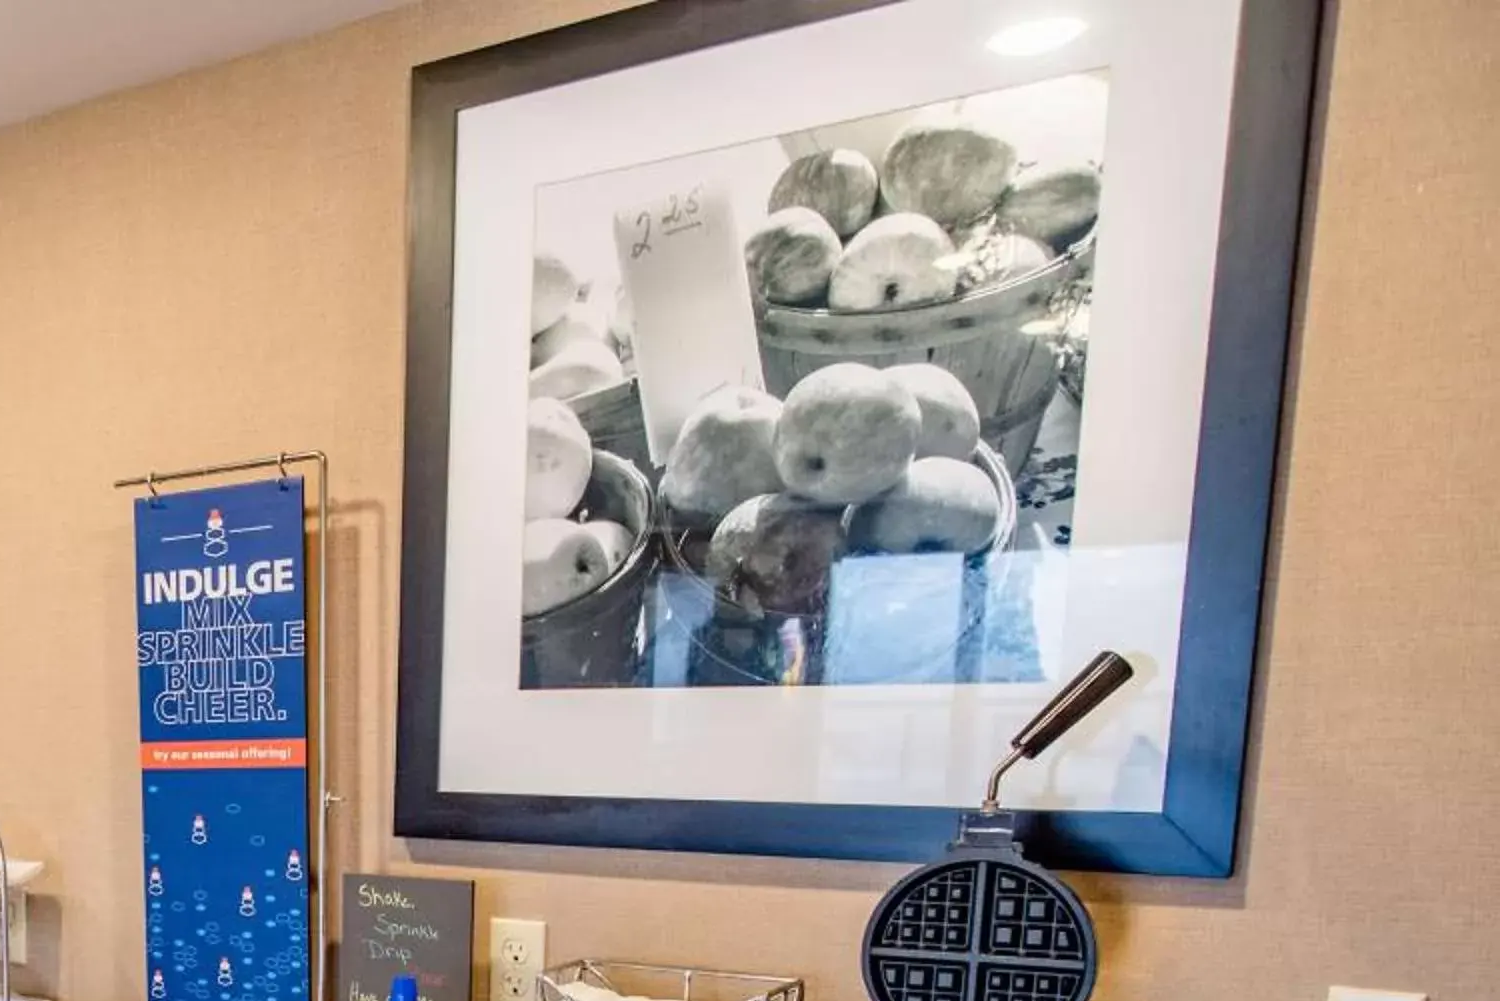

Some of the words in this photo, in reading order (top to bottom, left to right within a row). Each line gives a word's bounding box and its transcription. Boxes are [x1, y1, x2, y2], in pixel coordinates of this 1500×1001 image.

[143, 557, 296, 605] INDULGE
[181, 594, 256, 632] MIX
[136, 620, 305, 668] SPRINKLE
[165, 656, 276, 696] BUILD
[153, 686, 287, 726] CHEER.
[153, 748, 169, 763] try
[171, 751, 189, 761] our
[191, 746, 239, 761] seasonal
